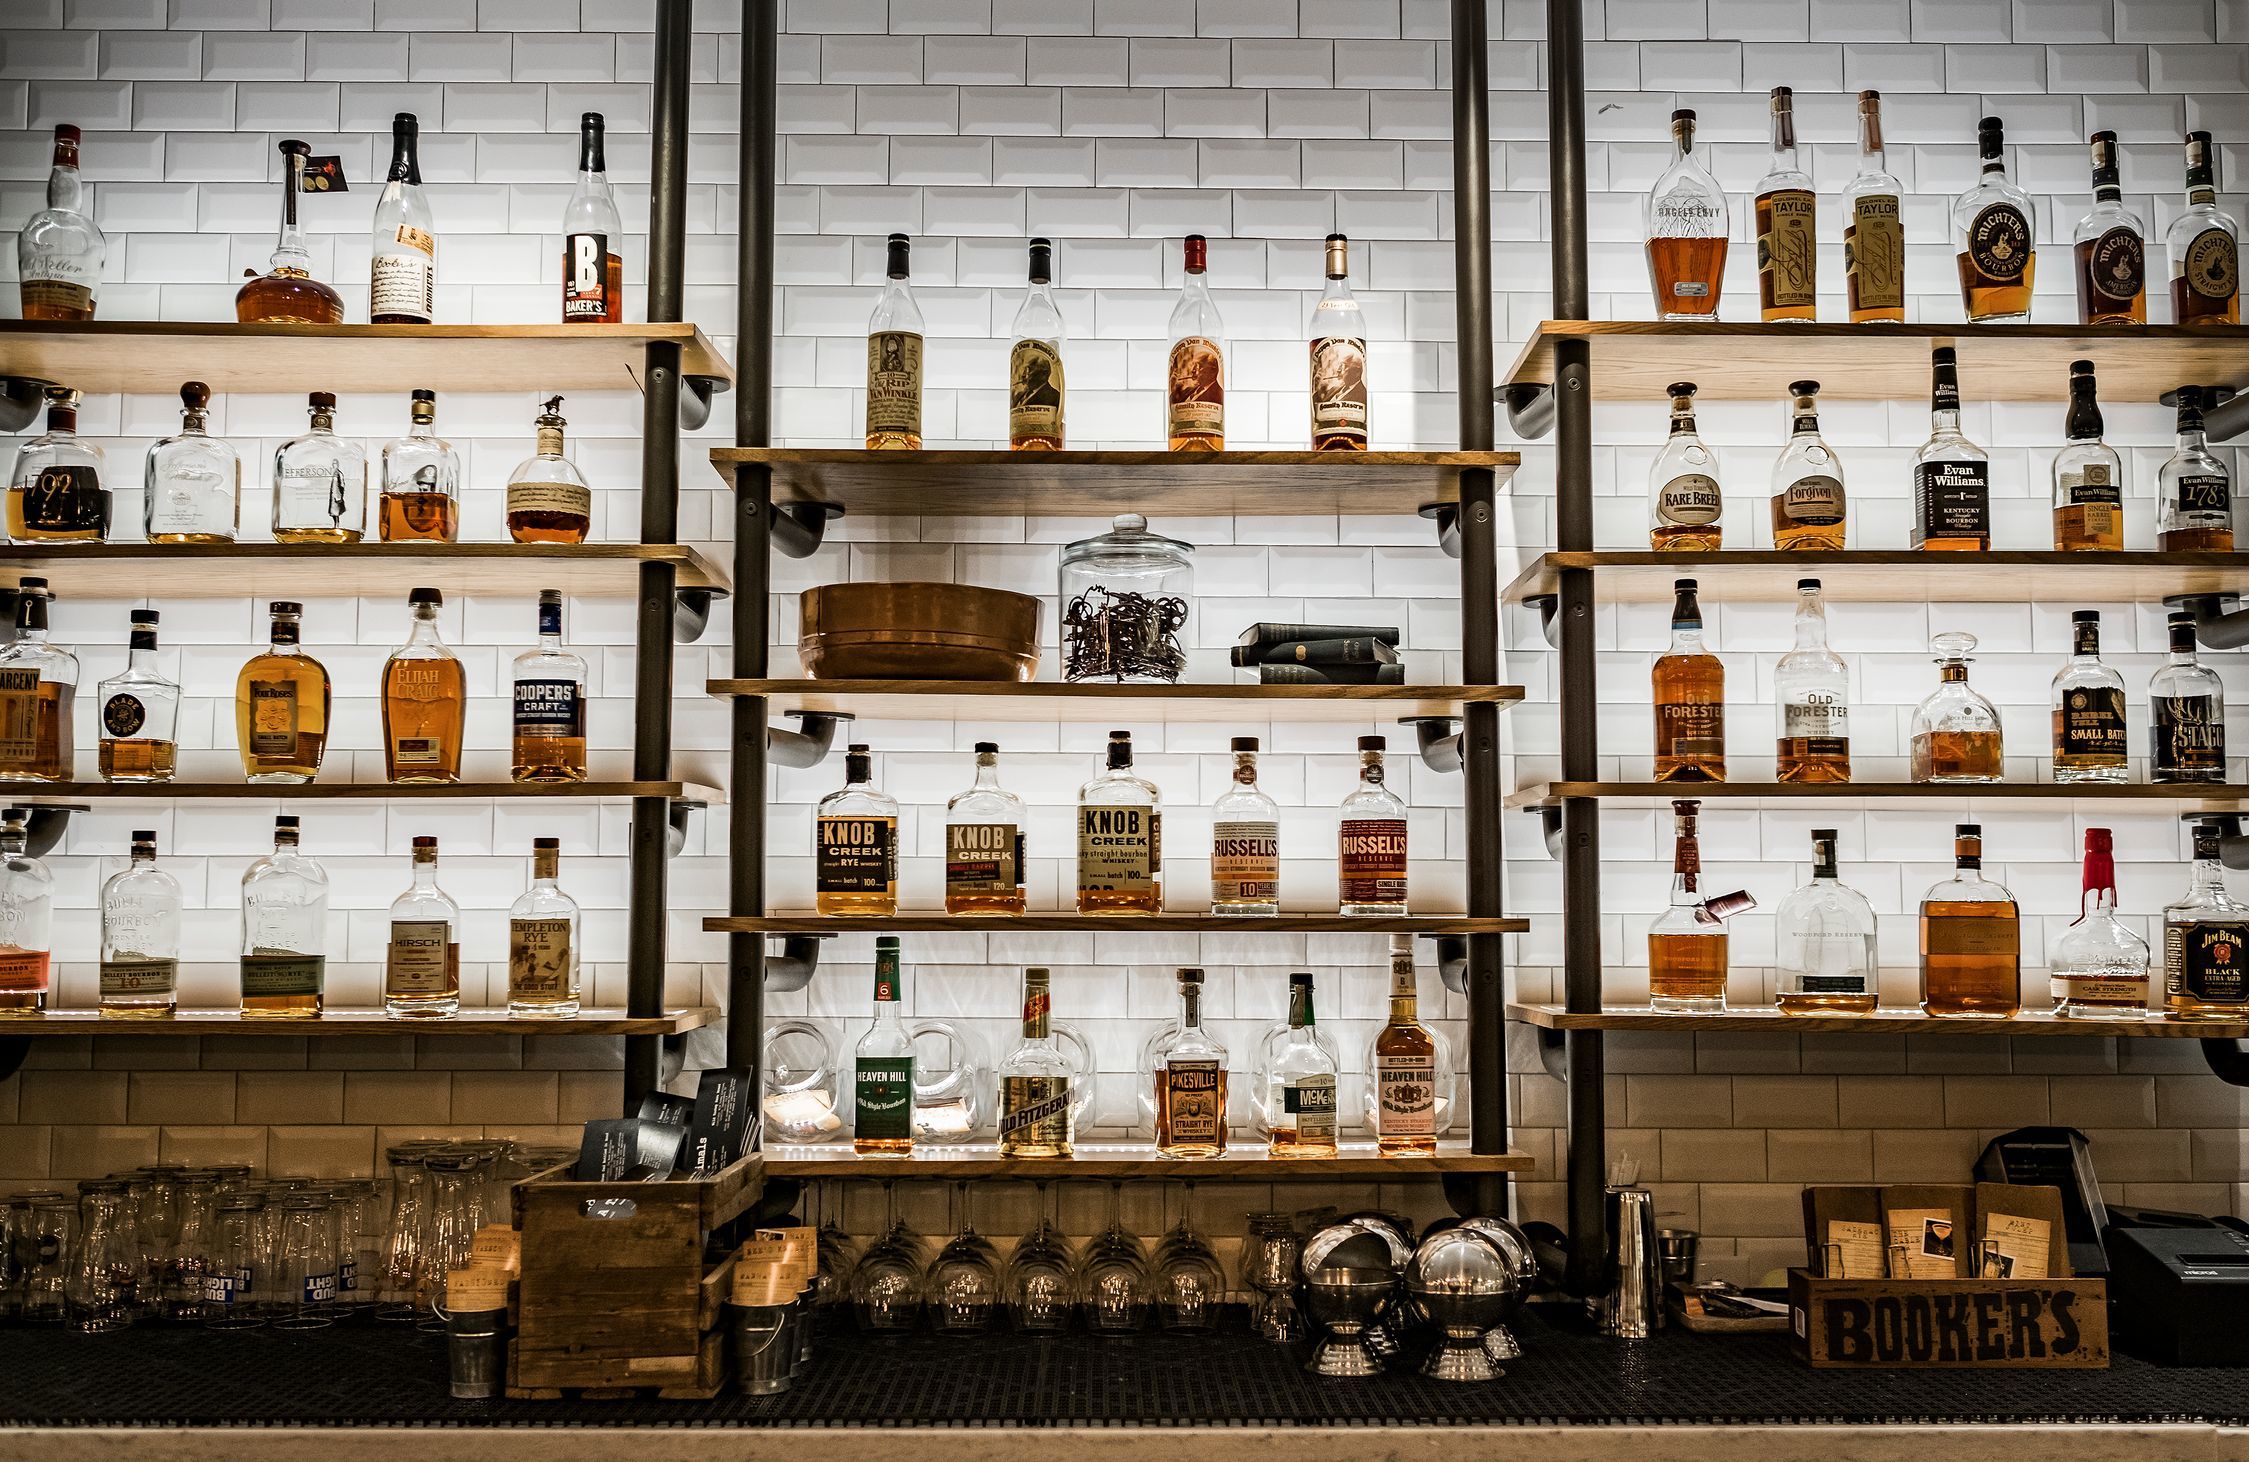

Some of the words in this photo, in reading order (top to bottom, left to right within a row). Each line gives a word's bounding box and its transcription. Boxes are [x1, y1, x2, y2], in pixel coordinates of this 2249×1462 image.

[1774, 203, 1813, 214] TAYLOR
[1858, 203, 1898, 216] TAYLOR
[1978, 212, 2025, 243] MICHTER'S
[2100, 235, 2142, 264] MICHTER'S
[2193, 237, 2236, 265] MICHTER'S
[575, 235, 598, 293] B
[1978, 251, 2026, 272] BOURBON
[565, 300, 603, 312] BAKER'S
[886, 380, 911, 388] RIP
[883, 386, 918, 400] WINKLE
[1943, 464, 1974, 475] Evan
[1790, 485, 1831, 500] Forgiven
[2075, 489, 2093, 497] Evan
[2185, 484, 2227, 507] 1783
[1665, 491, 1693, 507] RARE
[1693, 491, 1720, 506] BREED
[396, 669, 440, 685] ELIJAH
[396, 683, 441, 699] CRAIG
[515, 684, 575, 701] COOPERS'
[109, 697, 140, 710] BLADE
[1686, 693, 1711, 705] OLD
[1808, 693, 1833, 705] OLD
[523, 702, 559, 711] CRAFT
[1786, 704, 1848, 718] FORESTER
[2071, 729, 2104, 740] SMALL
[1085, 810, 1140, 835] KNOB
[823, 822, 875, 845] KNOB
[953, 826, 1005, 849] KNOB
[1091, 837, 1147, 846] CREEK
[1342, 836, 1407, 855] RUSSELL'S
[829, 847, 883, 856] CREEK
[1090, 849, 1118, 859] straight
[1120, 849, 1147, 858] bourbon
[1214, 838, 1277, 858] RUSSELL'S
[958, 851, 1012, 860] CREEK
[841, 858, 860, 867] RYE
[1107, 871, 1123, 879] batch
[1127, 870, 1140, 880] 100
[863, 878, 876, 887] 100
[993, 882, 1006, 891] 120
[1377, 880, 1396, 888] SINGLE
[1241, 882, 1256, 897] 10
[511, 922, 567, 933] TEMPLETON
[395, 939, 441, 947] HIRSCH
[524, 932, 549, 943] RYE
[2202, 931, 2219, 949] JIM
[2219, 929, 2242, 948] BEAM
[2205, 968, 2241, 976] BLACK
[880, 984, 889, 996] 6
[857, 1071, 888, 1082] HEAVEN
[889, 1071, 907, 1082] HILL
[1171, 1072, 1216, 1089] PIKESVILLE
[1381, 1071, 1416, 1083] HEAVEN
[1417, 1071, 1433, 1082] HILL
[1000, 1115, 1017, 1135] OLD
[1017, 1088, 1075, 1128] FITZGERAL
[1175, 1120, 1201, 1128] STRAIGHT
[1202, 1120, 1213, 1128] RYE
[1827, 1289, 2081, 1363] BOOKER'S
